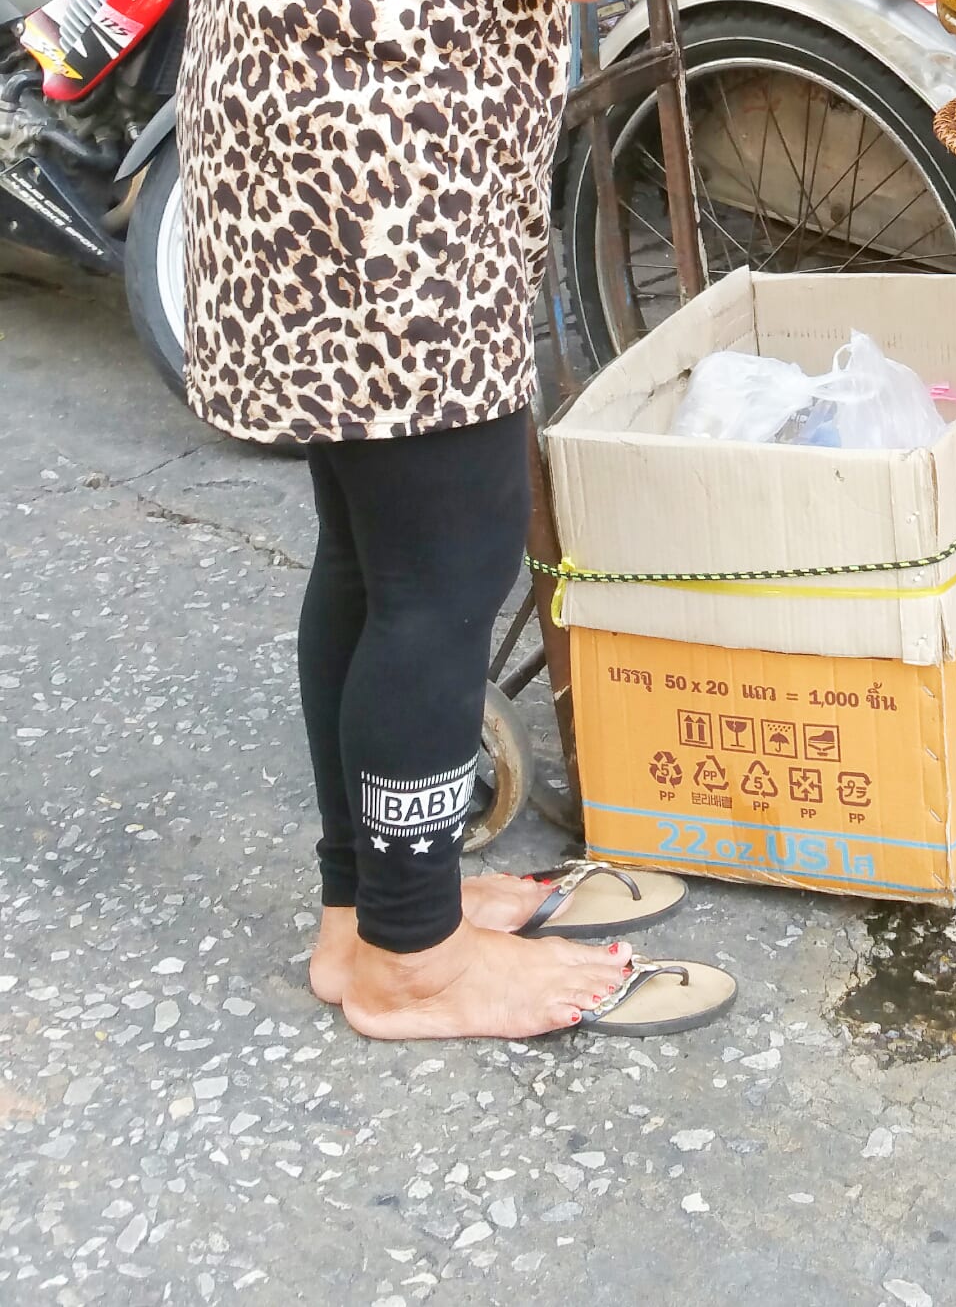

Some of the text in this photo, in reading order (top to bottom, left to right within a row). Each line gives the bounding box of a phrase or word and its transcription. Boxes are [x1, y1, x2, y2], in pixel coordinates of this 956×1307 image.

[608, 666, 653, 693] บรรจุ
[665, 675, 687, 691] 50
[706, 680, 729, 695] 20
[742, 683, 776, 702] แถว
[809, 689, 859, 708] 1,000
[866, 682, 897, 711] ชิ้น
[661, 764, 670, 776] 5
[703, 769, 717, 780] PP
[753, 777, 763, 790] 5
[384, 782, 466, 822] BABY
[659, 790, 676, 802] PP
[753, 800, 770, 813] PP
[800, 808, 817, 819] PP
[849, 812, 866, 824] PP
[657, 821, 709, 856] 22
